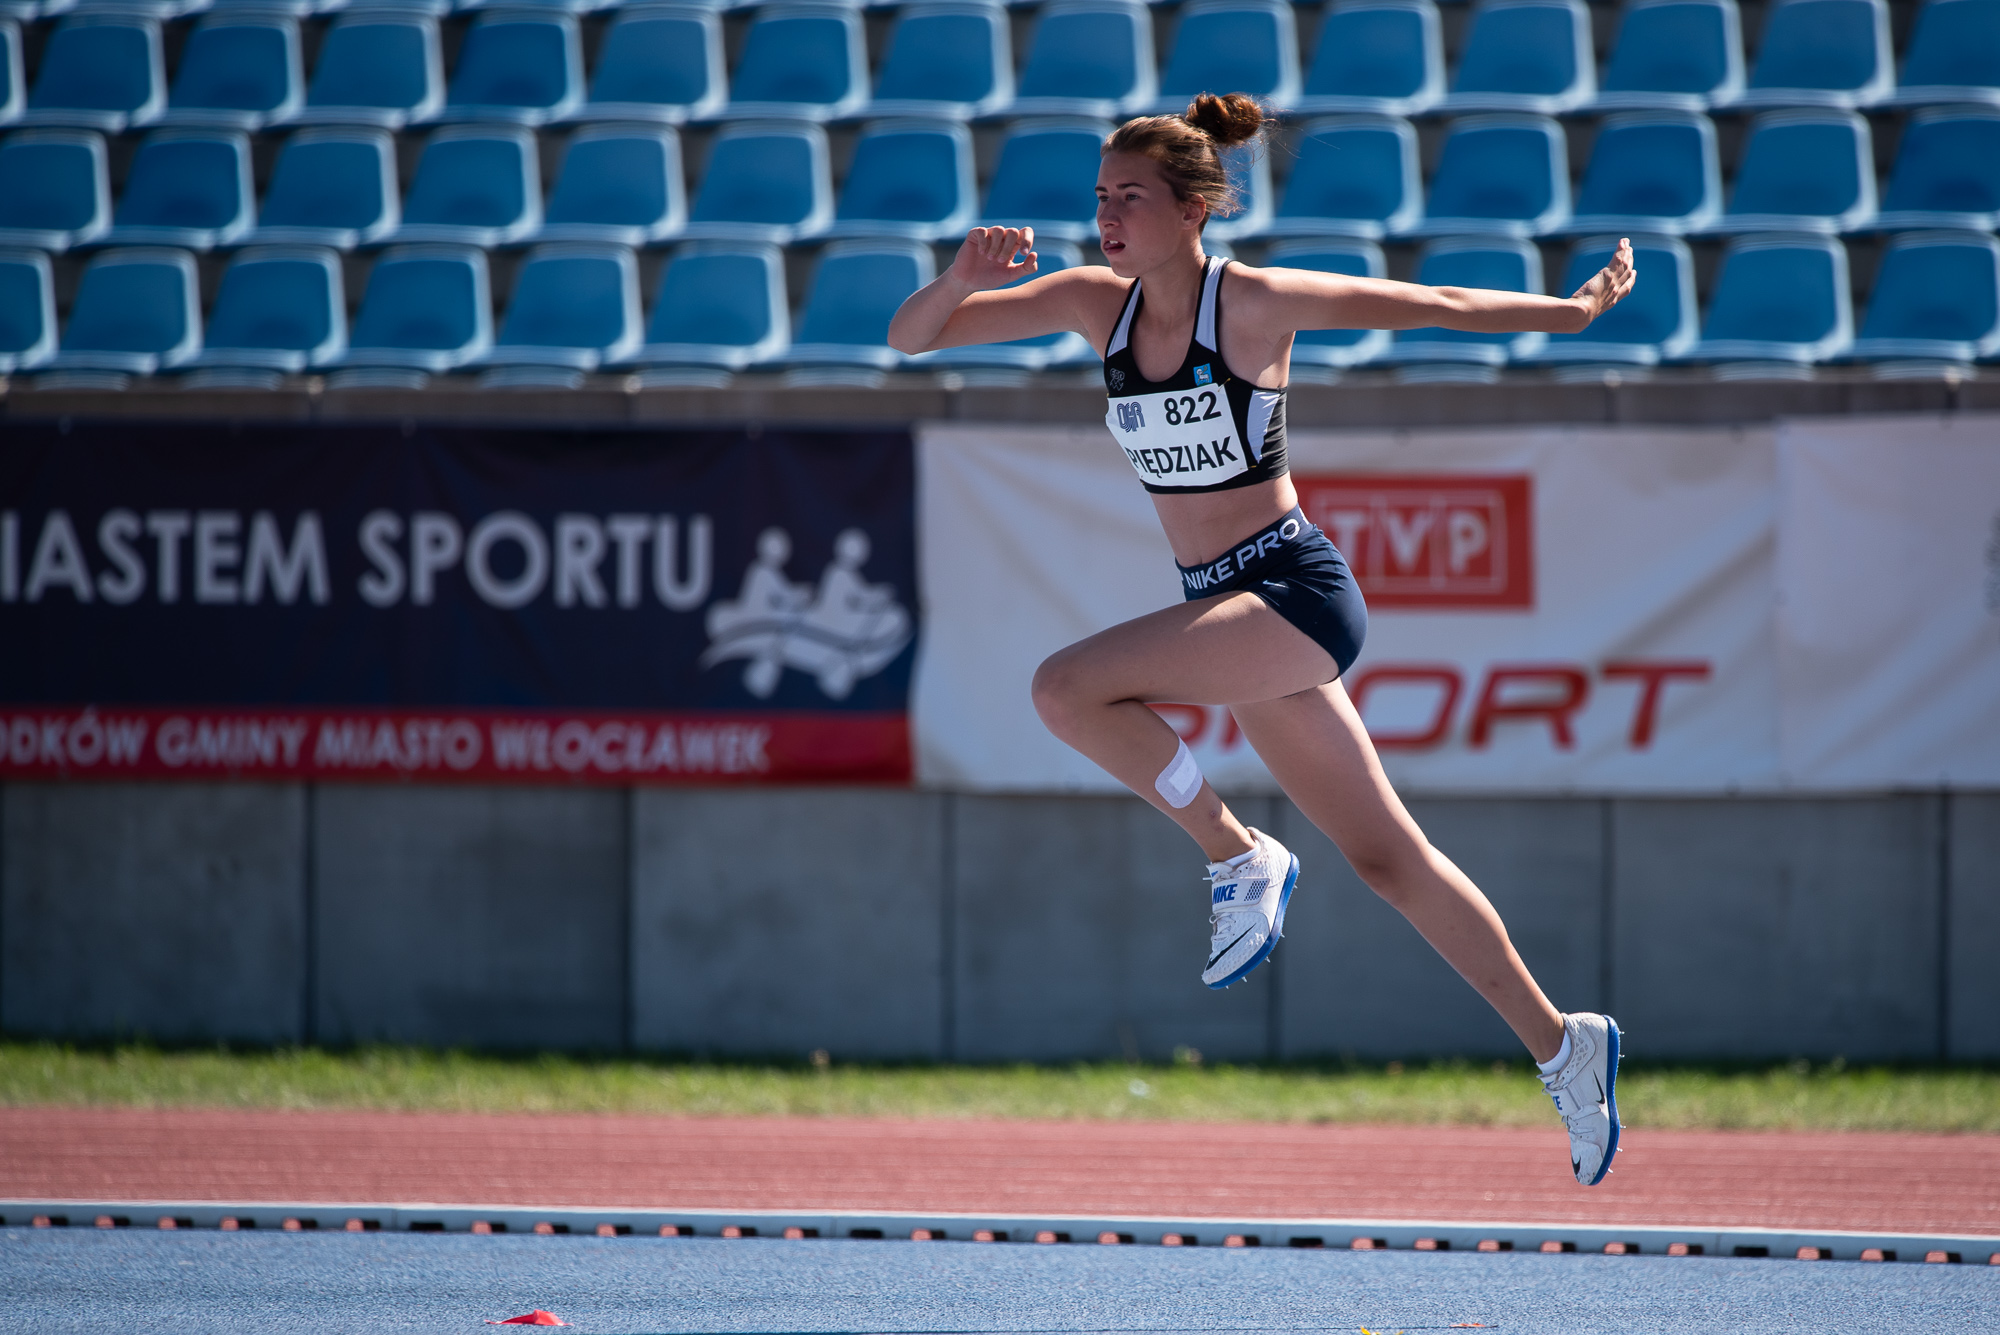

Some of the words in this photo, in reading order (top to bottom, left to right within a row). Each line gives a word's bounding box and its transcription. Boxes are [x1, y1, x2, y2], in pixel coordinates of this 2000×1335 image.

[1164, 391, 1221, 426] 822
[359, 511, 714, 609] SPORTU
[1184, 556, 1235, 590] NIKE
[1235, 518, 1300, 571] PRO
[1329, 510, 1490, 571] TVP
[1146, 658, 1713, 752] ORT
[155, 715, 308, 769] GMINY
[313, 717, 483, 771] MIASTO
[490, 719, 772, 775] WŁOCŁAWEK
[1212, 883, 1238, 904] NIKE
